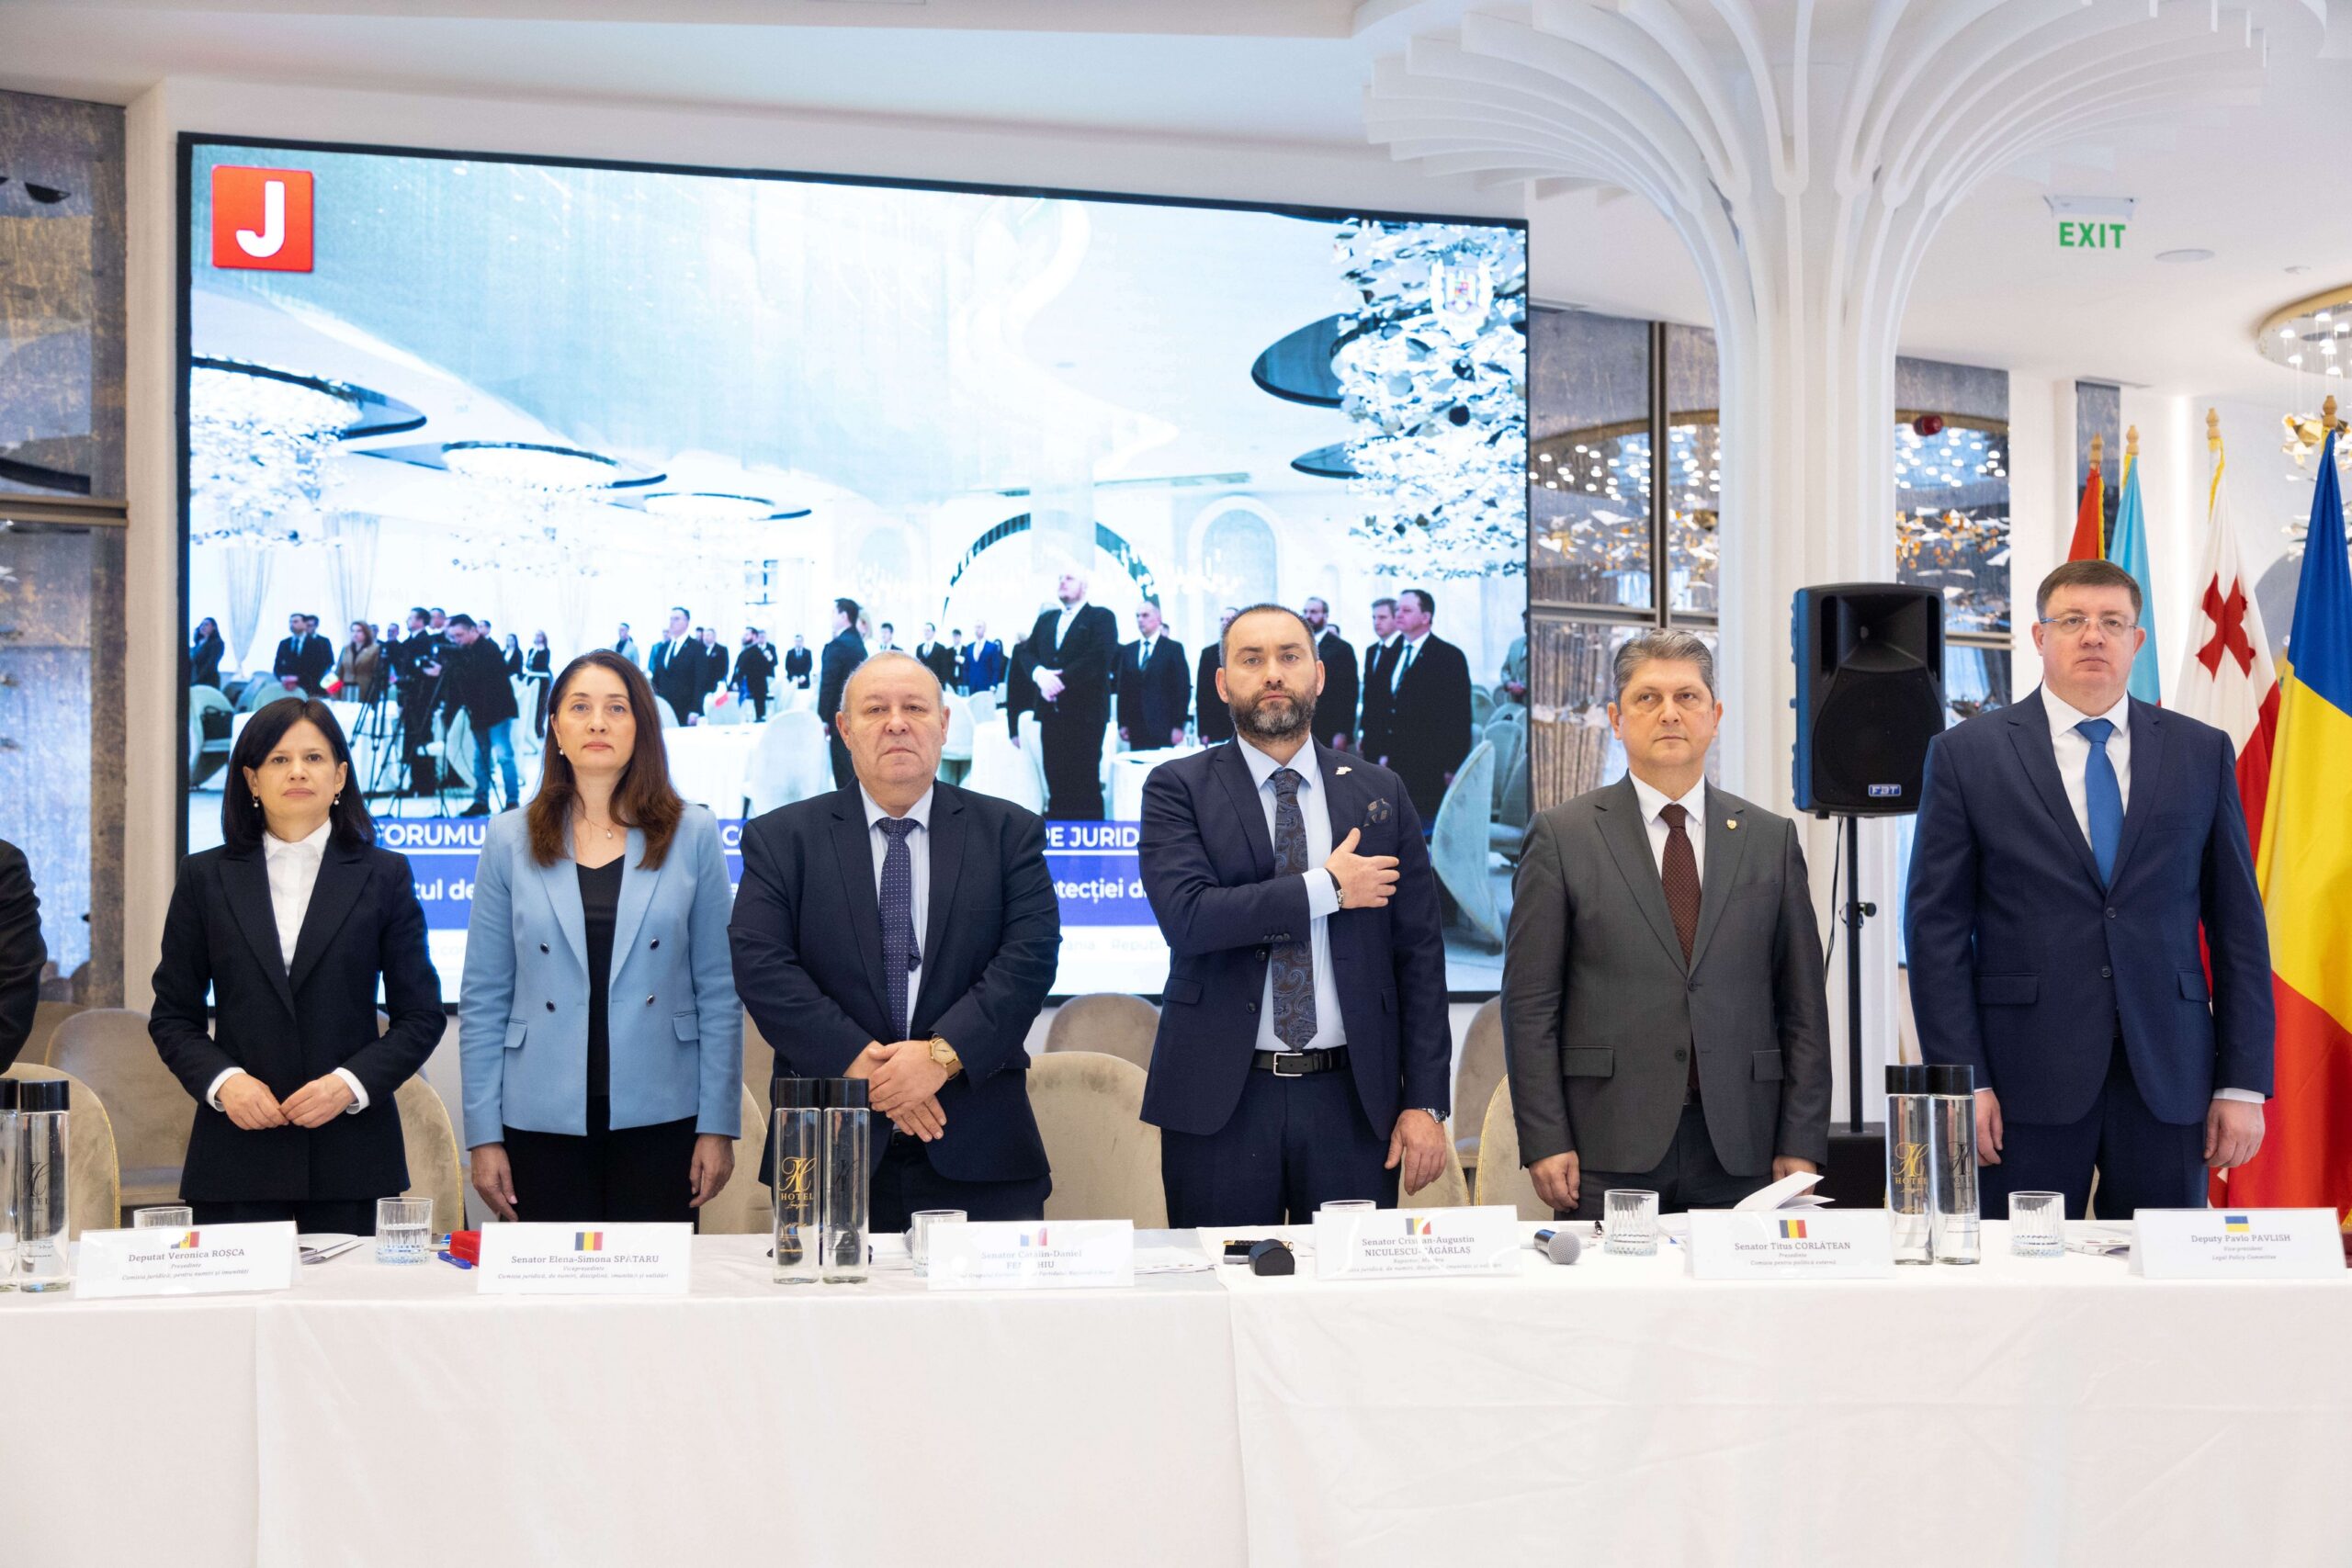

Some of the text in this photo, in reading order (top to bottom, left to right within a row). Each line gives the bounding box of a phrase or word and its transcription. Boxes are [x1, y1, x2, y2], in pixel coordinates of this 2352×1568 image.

[235, 179, 285, 258] J
[2059, 221, 2126, 249] EXIT
[372, 823, 486, 846] ORUMU
[1069, 827, 1140, 848] JURID
[1053, 877, 1124, 905] tecției
[780, 1192, 814, 1201] HOTEL
[1362, 1235, 1475, 1246] Senator Crisan-Augustin
[2191, 1235, 2222, 1245] Deputy
[2251, 1234, 2290, 1242] PAVLISH
[1735, 1242, 1768, 1250] Senator
[1770, 1242, 1792, 1250] Titus
[129, 1253, 165, 1263] Deputat
[168, 1250, 209, 1259] Veronica
[511, 1255, 547, 1263] Senator
[548, 1255, 611, 1263] Elena-Simona
